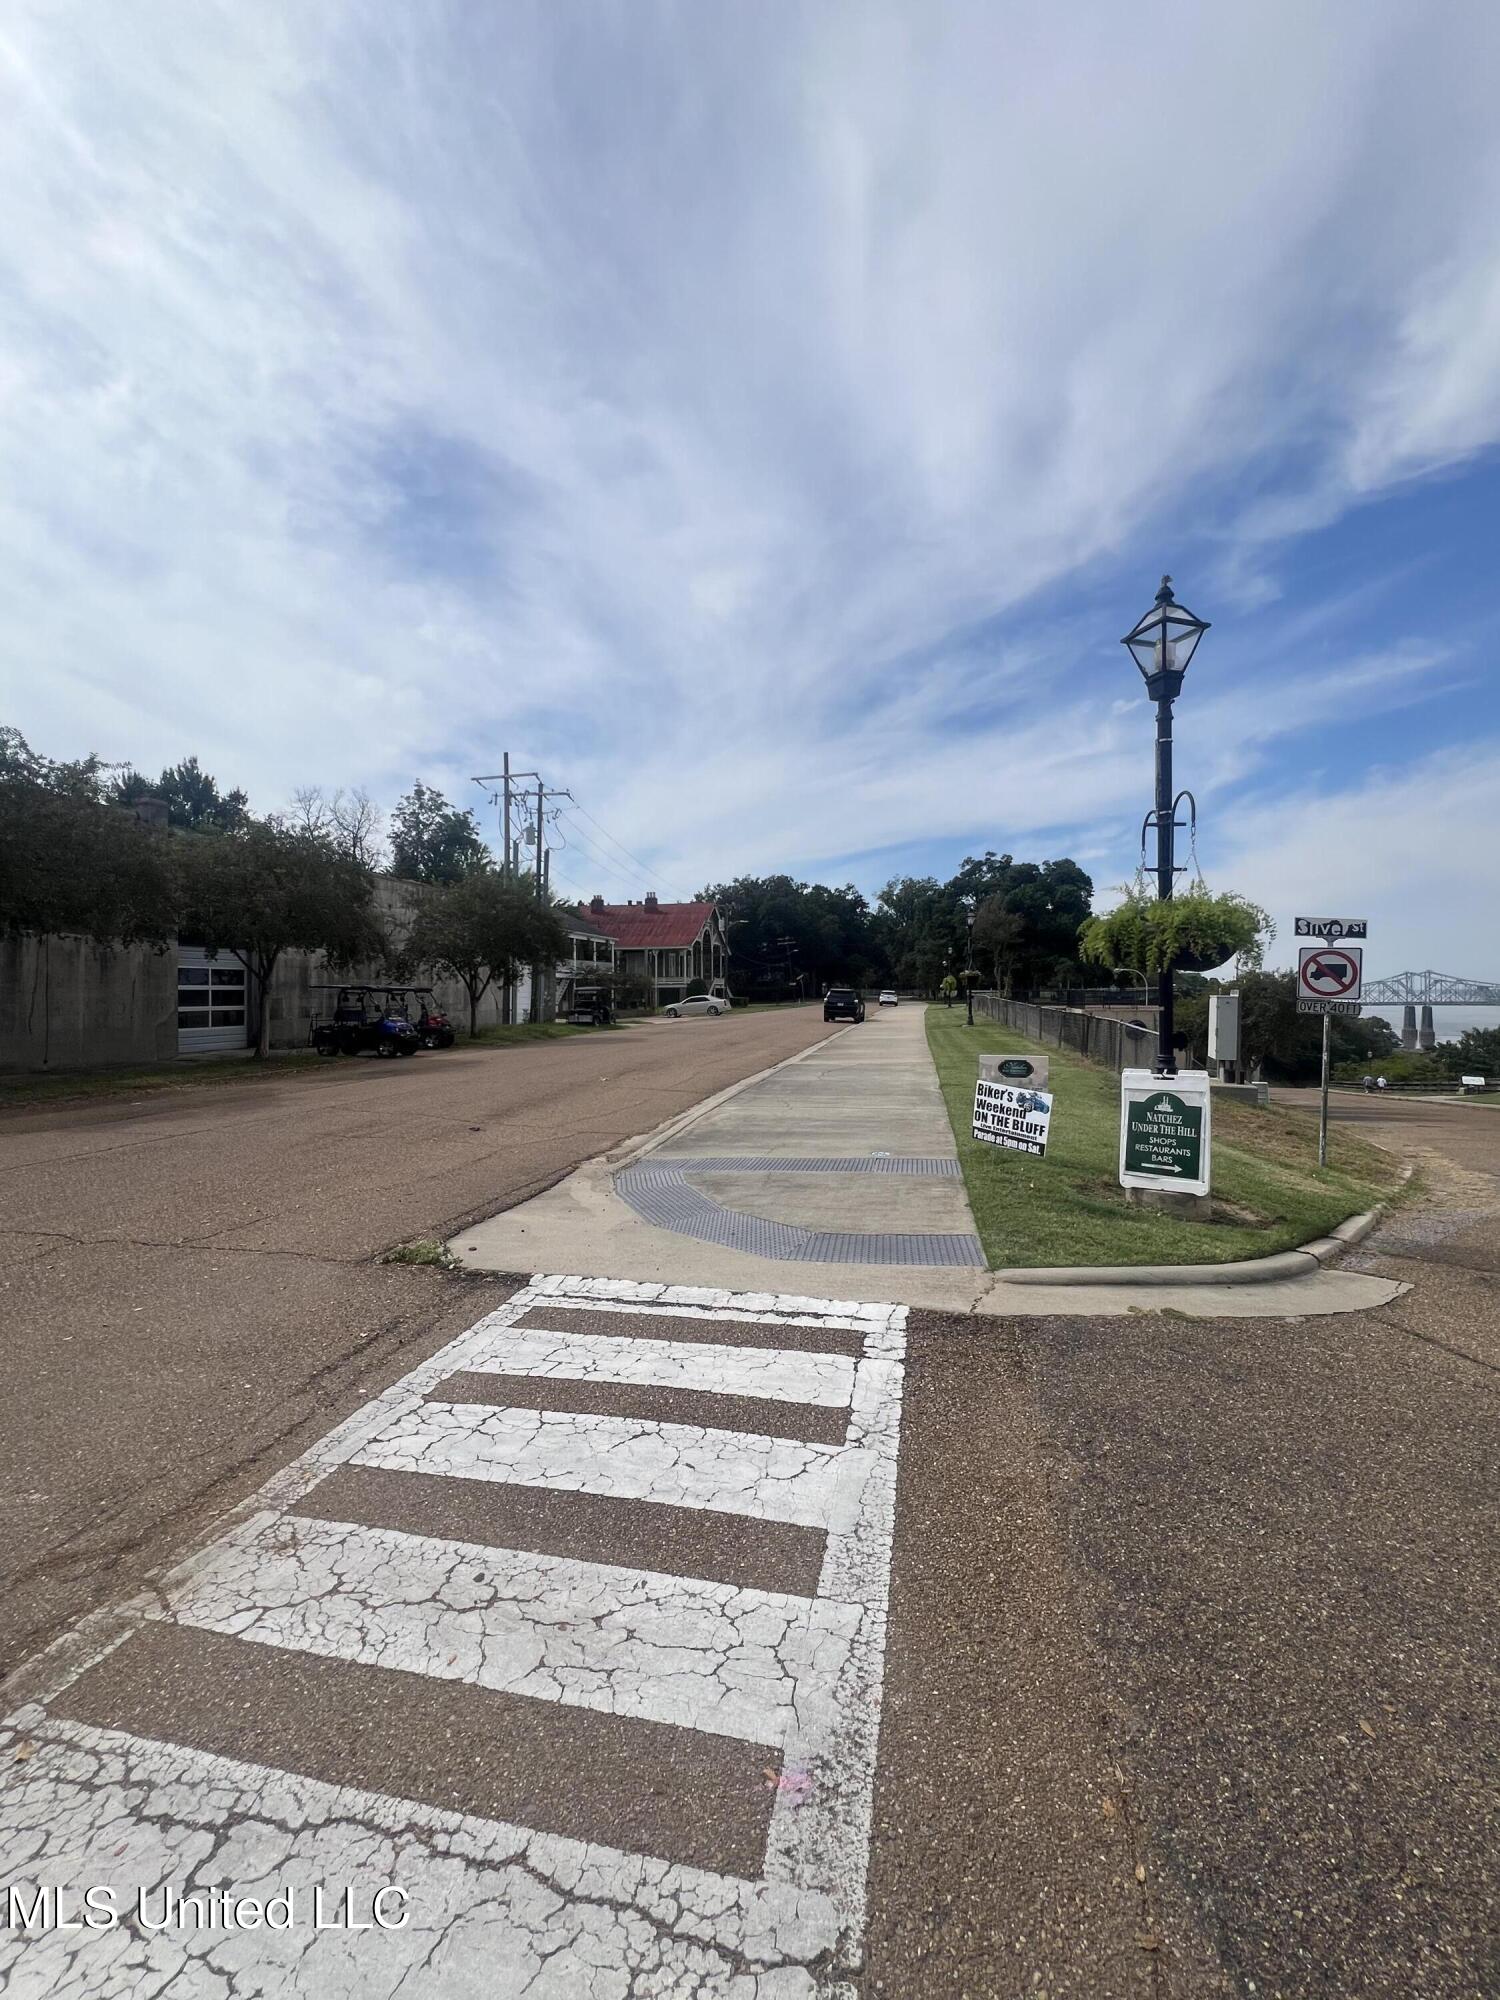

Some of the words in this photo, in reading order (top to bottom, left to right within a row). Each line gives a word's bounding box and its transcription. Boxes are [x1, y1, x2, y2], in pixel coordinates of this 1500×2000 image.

[1297, 919, 1349, 935] Silver
[1299, 1001, 1326, 1012] OVER
[977, 1083, 1014, 1102] Biker's
[976, 1097, 1027, 1119] Weekend
[974, 1110, 988, 1123] ON
[990, 1114, 1010, 1129] THE
[1012, 1119, 1046, 1136] BLUFF
[1146, 1111, 1183, 1124] NATCHEZ
[992, 1126, 1037, 1140] Entertainment
[1131, 1121, 1159, 1133] UNDER
[1159, 1124, 1176, 1135] THE
[1177, 1126, 1197, 1137] HILL
[973, 1128, 996, 1142] Parade
[995, 1135, 1003, 1145] at
[1003, 1136, 1018, 1149] 5pm
[1018, 1140, 1027, 1151] on
[1027, 1142, 1041, 1155] Sat.
[1149, 1136, 1177, 1146] SHOPS
[1135, 1143, 1191, 1156] RESTAURANTS
[1151, 1154, 1173, 1164] BARS
